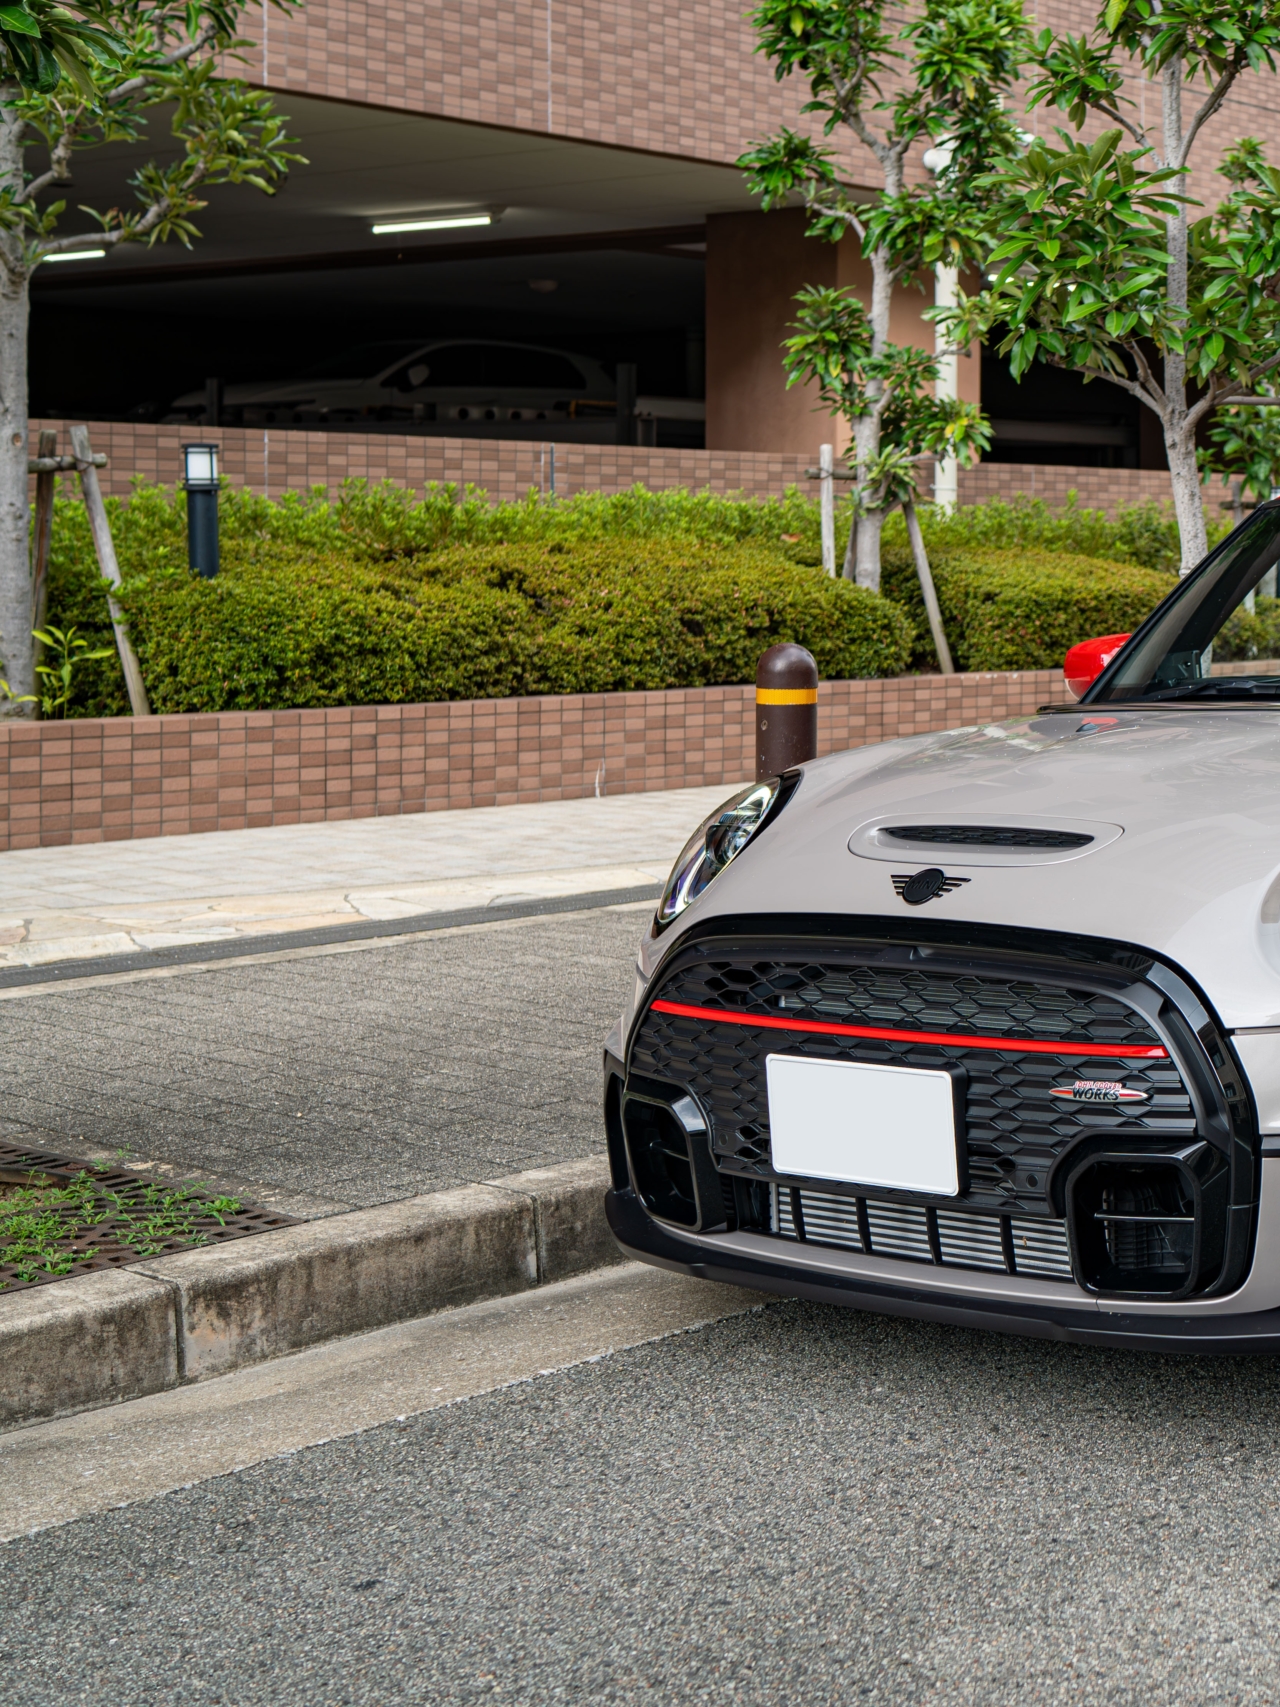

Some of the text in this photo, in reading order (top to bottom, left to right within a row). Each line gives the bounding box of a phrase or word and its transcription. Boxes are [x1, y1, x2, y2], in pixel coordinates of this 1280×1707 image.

[908, 880, 938, 890] MINI
[1073, 1080, 1094, 1088] JOHN
[1072, 1087, 1120, 1101] WORKS
